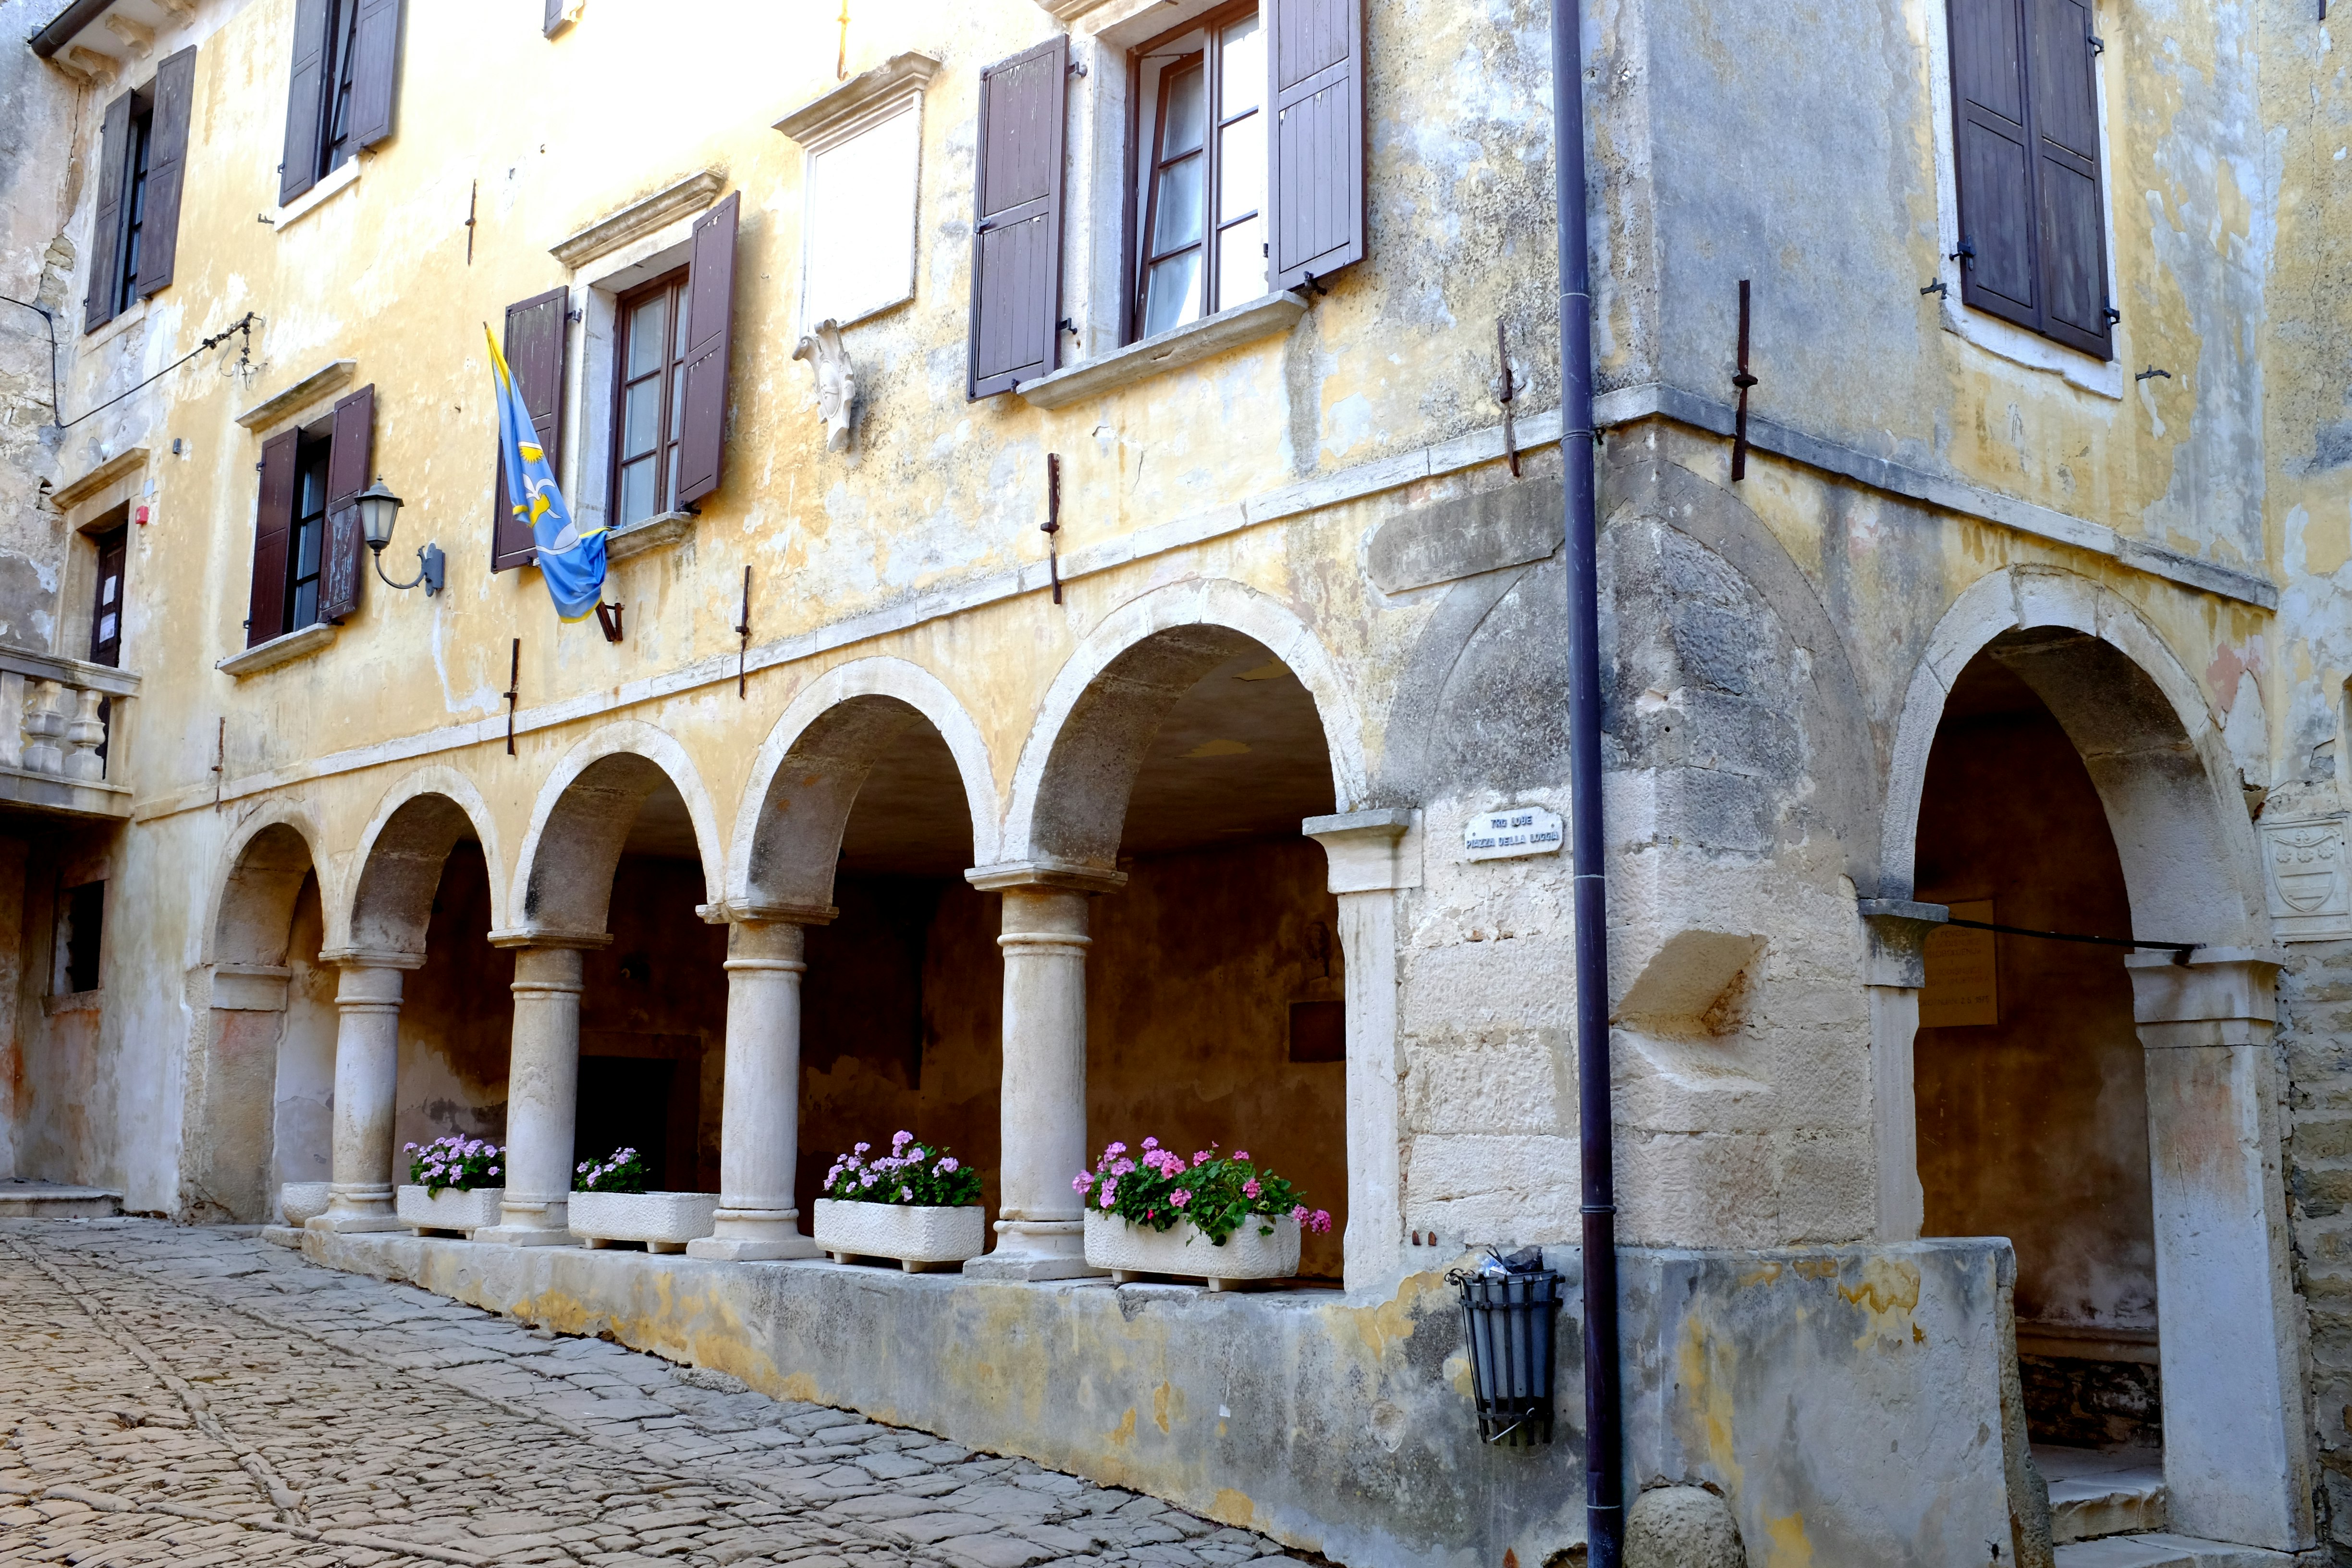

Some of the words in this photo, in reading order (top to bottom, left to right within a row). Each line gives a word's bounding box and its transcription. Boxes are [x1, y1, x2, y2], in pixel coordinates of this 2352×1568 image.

[1491, 819, 1507, 828] TRG
[1466, 837, 1495, 849] PIAZZA
[1498, 835, 1526, 846] DELLA
[1530, 832, 1559, 843] LOGGIA
